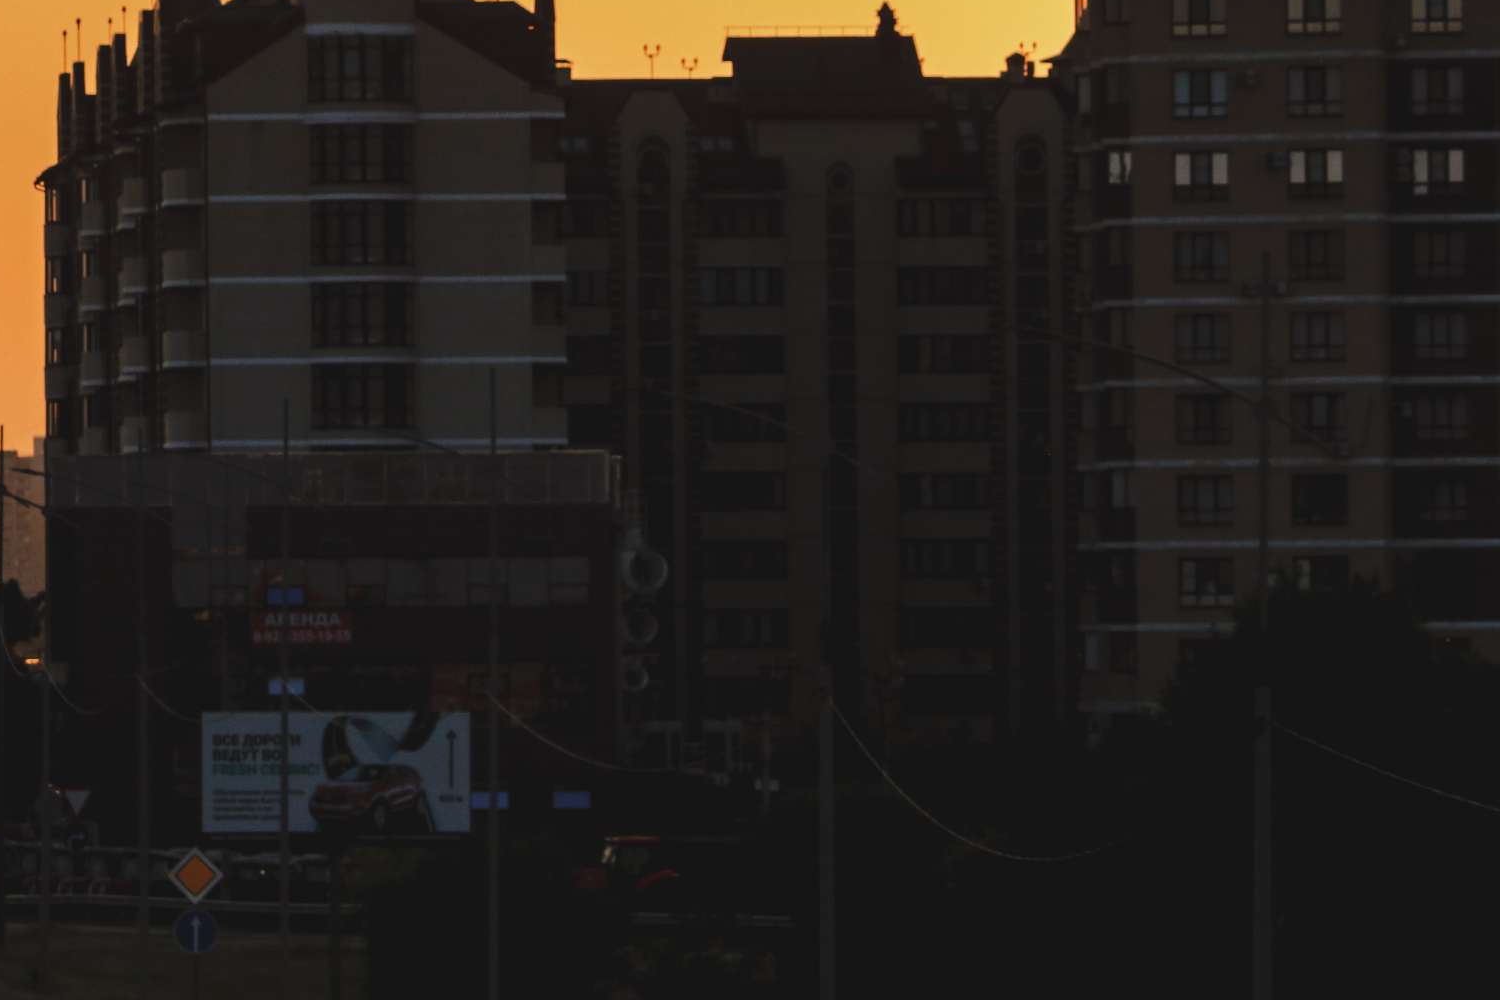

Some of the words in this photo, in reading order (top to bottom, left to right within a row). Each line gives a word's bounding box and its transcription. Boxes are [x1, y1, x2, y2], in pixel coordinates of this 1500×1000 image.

[212, 734, 240, 746] ВСЕ
[243, 734, 301, 747] ДОРОИ
[212, 749, 259, 762] ВЕДУТ
